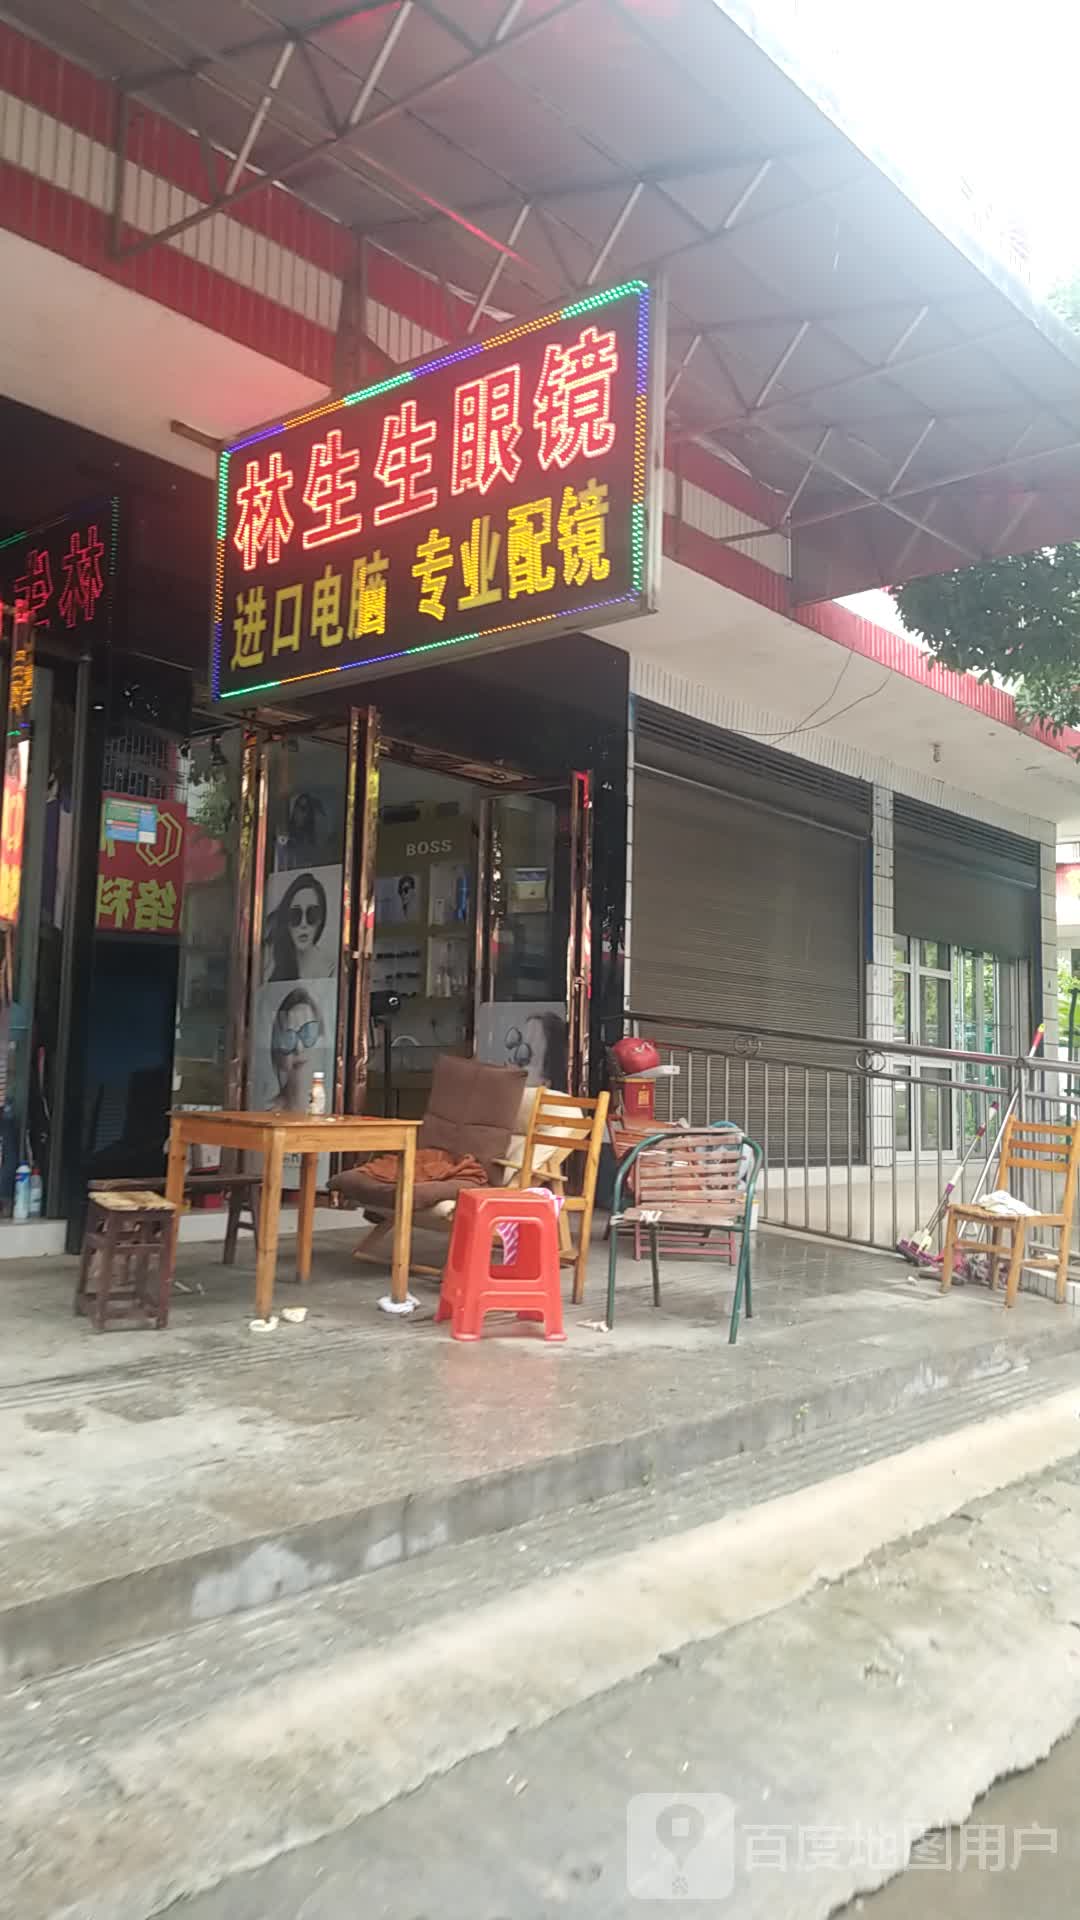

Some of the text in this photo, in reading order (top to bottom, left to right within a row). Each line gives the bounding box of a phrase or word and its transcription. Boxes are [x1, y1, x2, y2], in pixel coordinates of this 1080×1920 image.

[233, 325, 619, 572] 林生生眼镜
[230, 478, 611, 671] 进口电脑 专业配镜
[406, 839, 452, 857] BOSS
